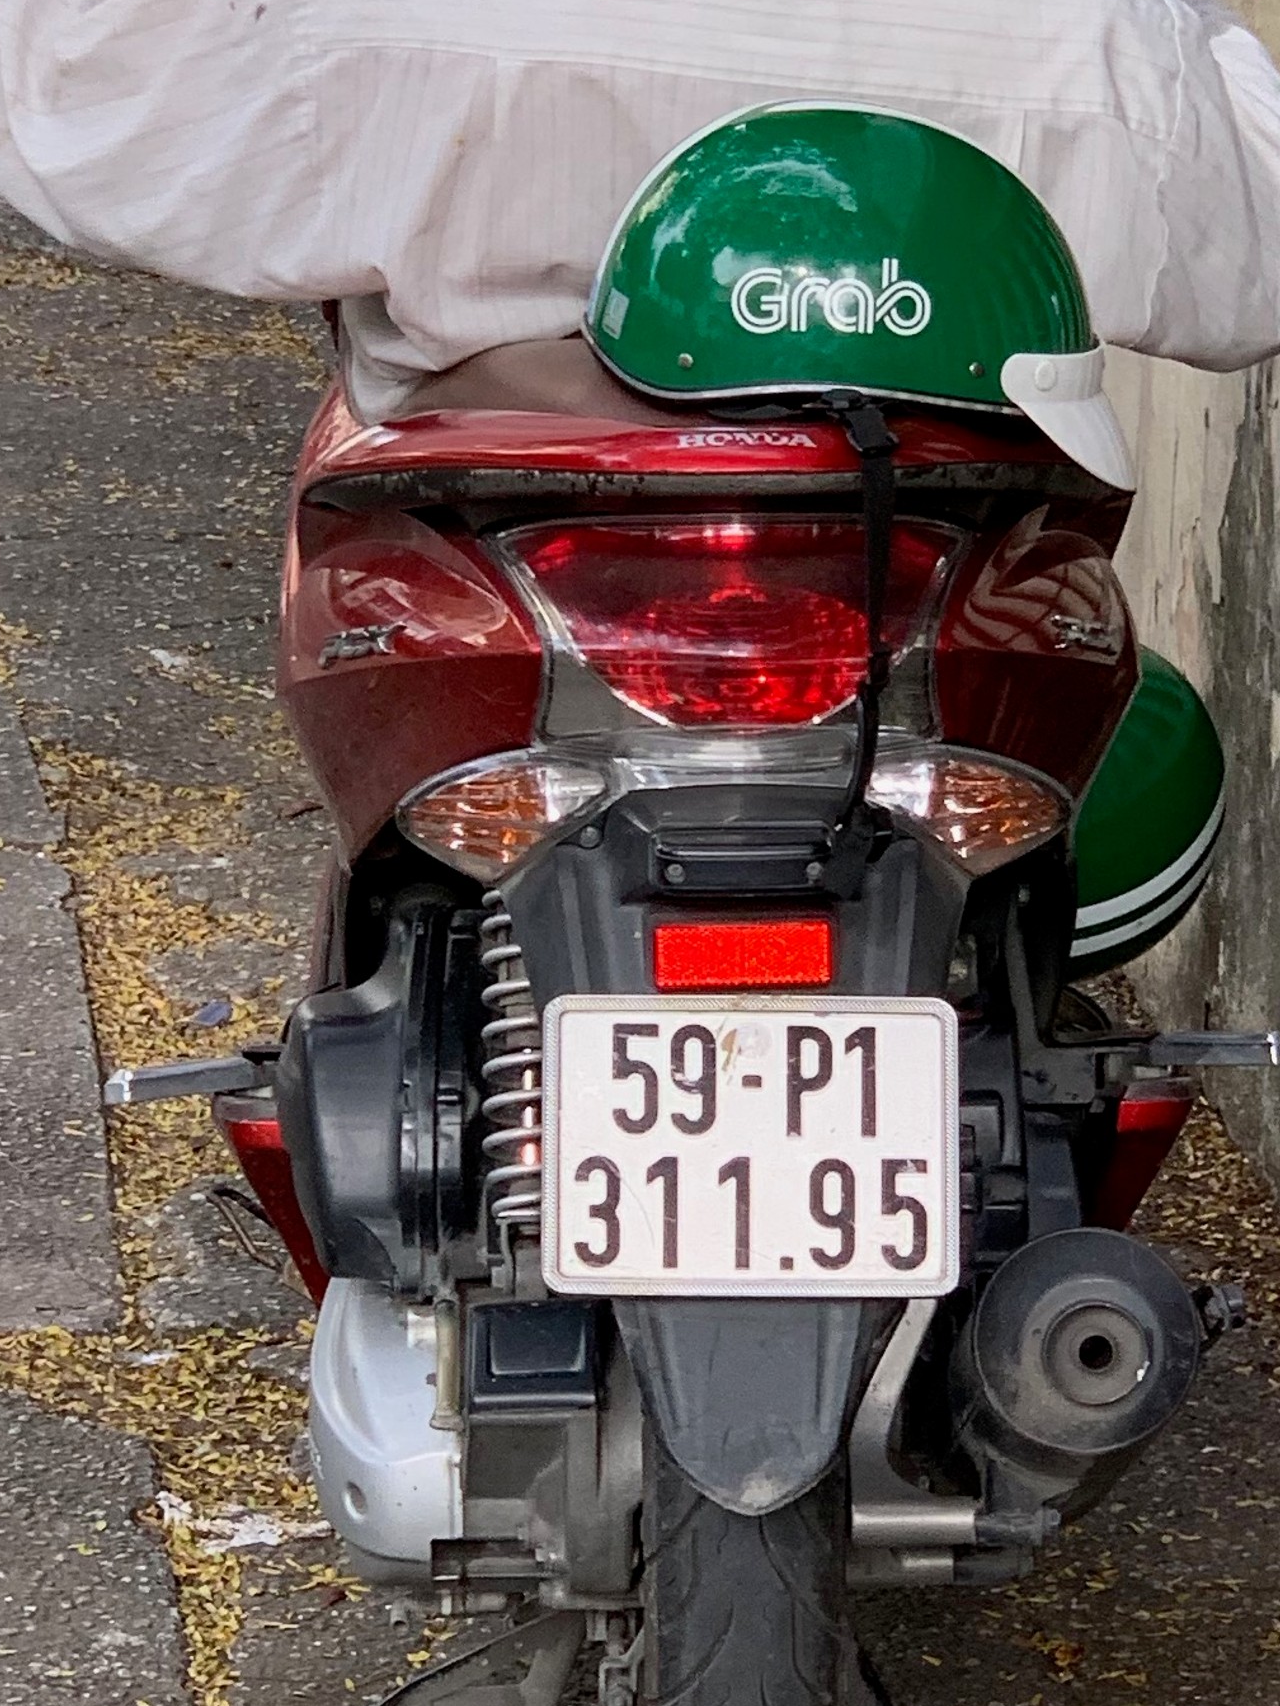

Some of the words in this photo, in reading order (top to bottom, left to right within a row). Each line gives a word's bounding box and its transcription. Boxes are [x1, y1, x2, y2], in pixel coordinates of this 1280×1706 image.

[731, 257, 932, 337] Grab
[676, 432, 818, 450] HONDA
[611, 1022, 877, 1138] 59-P1
[573, 1155, 929, 1272] 311.95
